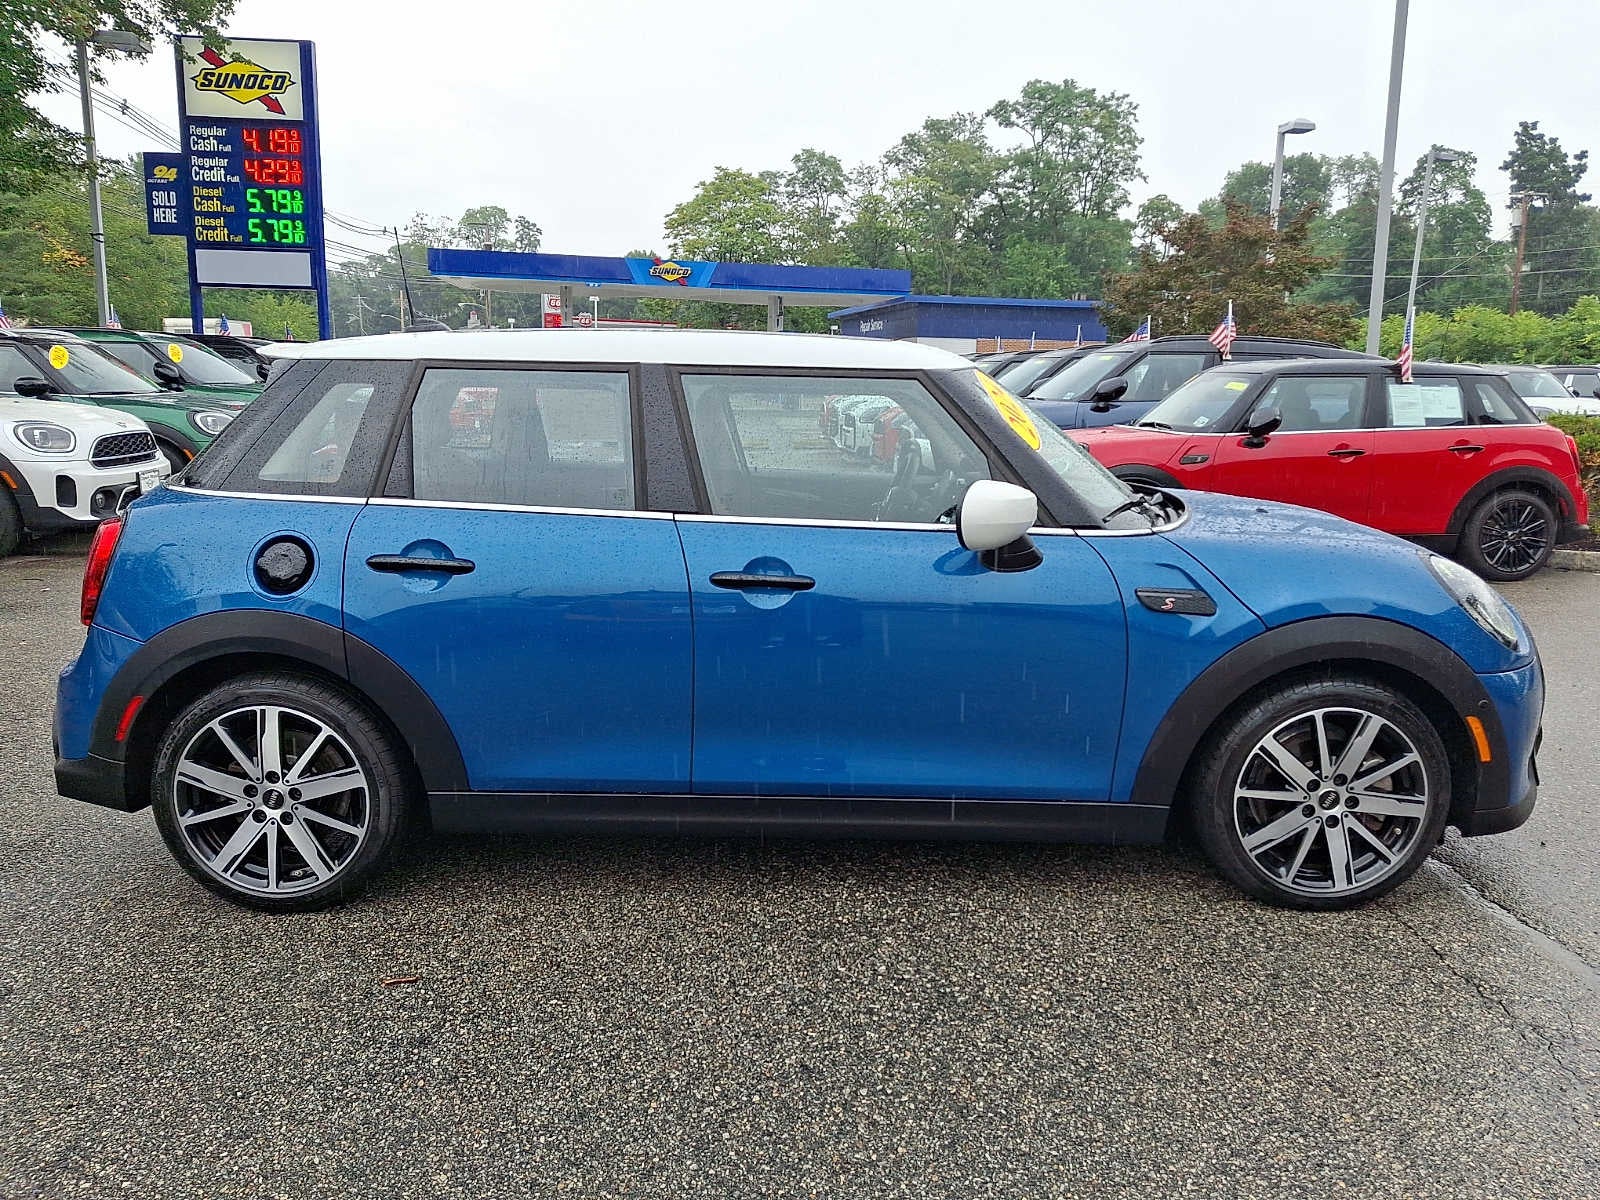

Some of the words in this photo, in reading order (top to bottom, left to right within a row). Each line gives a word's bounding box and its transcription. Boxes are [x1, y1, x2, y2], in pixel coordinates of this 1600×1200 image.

[199, 71, 287, 91] SUNOCO
[189, 125, 227, 137] Regular
[190, 136, 218, 152] Cash
[219, 144, 232, 152] Full
[191, 156, 229, 168] Regular
[153, 165, 178, 182] 94
[191, 166, 226, 183] Credit
[152, 190, 177, 206] SOLD
[193, 186, 223, 197] Diesel
[193, 196, 221, 212] Cash
[153, 207, 178, 224] HERE
[194, 215, 224, 226] Diesel
[195, 226, 229, 242] Credit
[651, 266, 690, 276] SUNOCO
[1161, 597, 1176, 610] S
